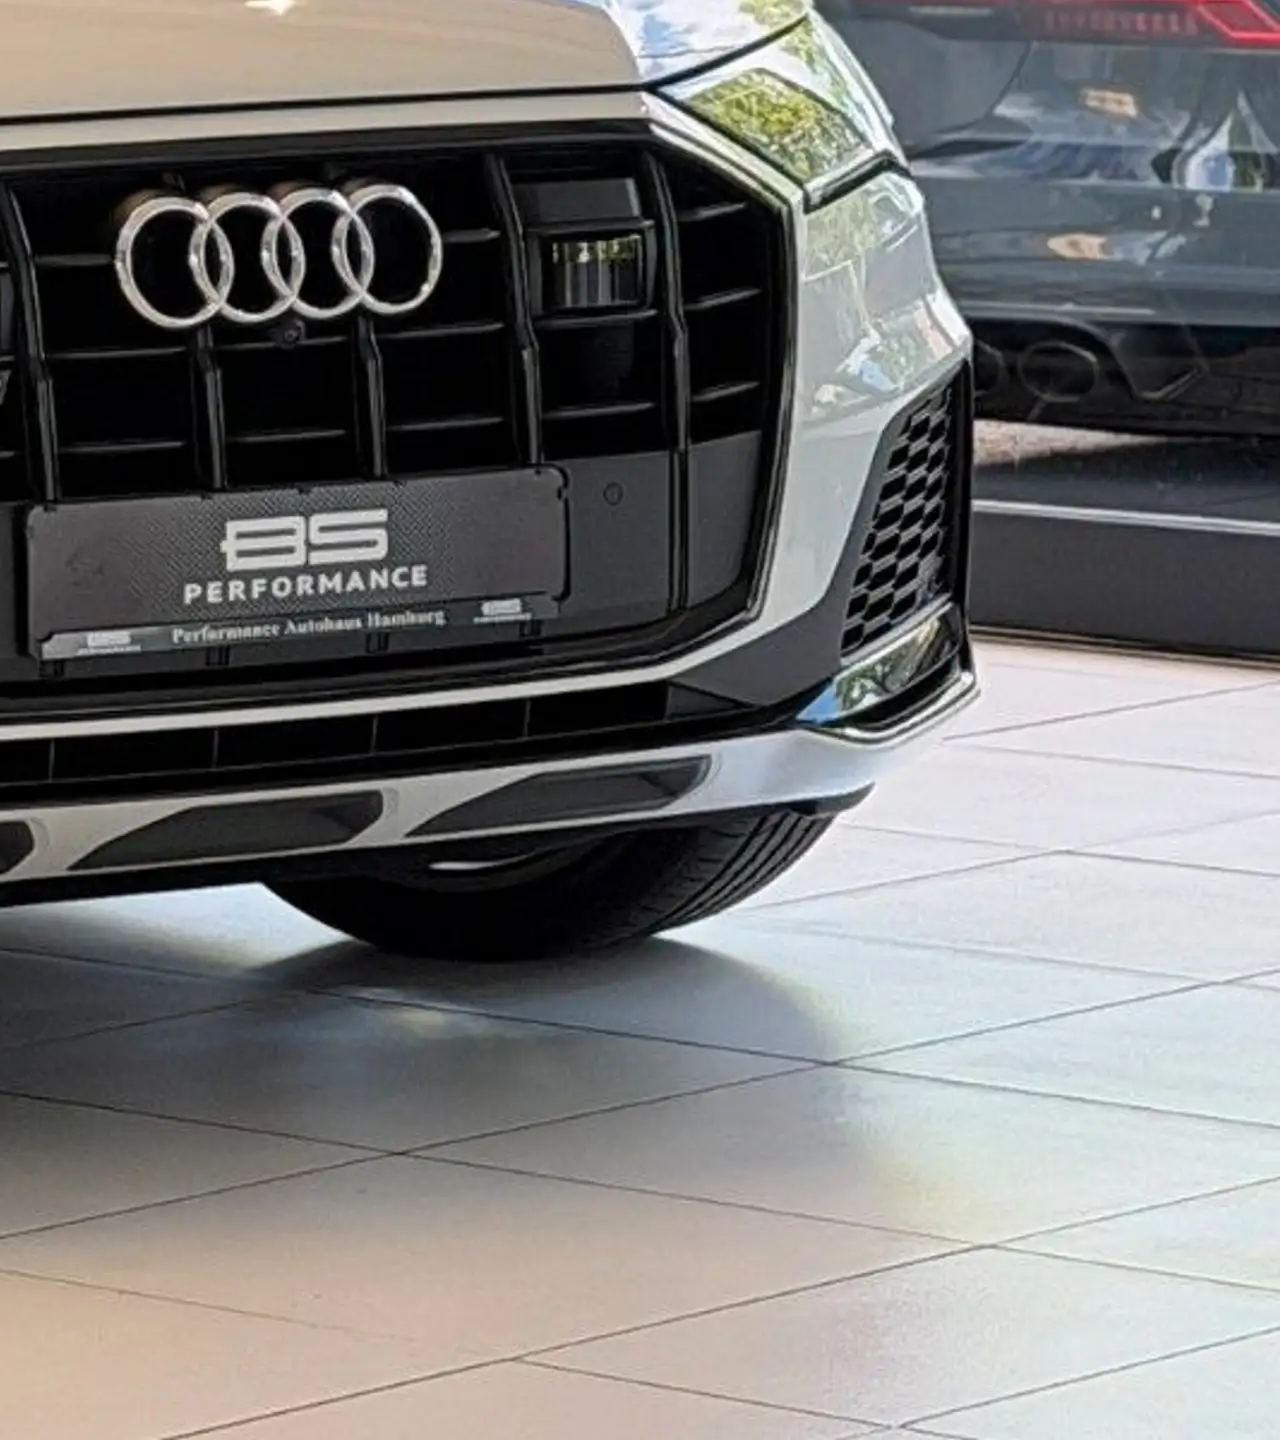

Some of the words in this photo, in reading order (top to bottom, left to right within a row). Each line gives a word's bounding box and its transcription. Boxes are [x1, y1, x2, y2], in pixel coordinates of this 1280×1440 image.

[183, 564, 428, 605] PERFORMANCE
[171, 623, 279, 644] Performance
[284, 617, 363, 635] Autohaus
[367, 610, 446, 628] Hamburg
